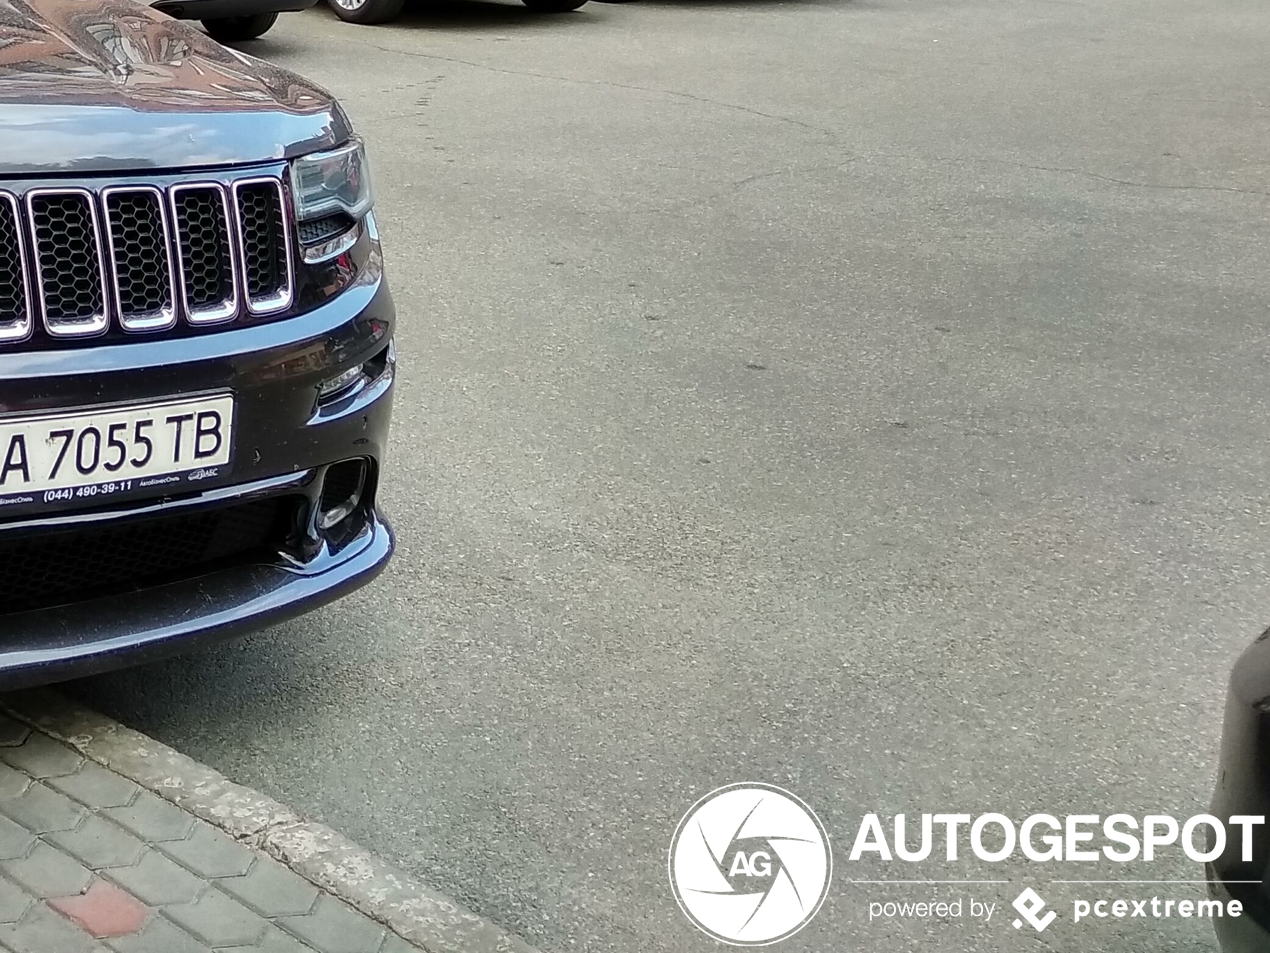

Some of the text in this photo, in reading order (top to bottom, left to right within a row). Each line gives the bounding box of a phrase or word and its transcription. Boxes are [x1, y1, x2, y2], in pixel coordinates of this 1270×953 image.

[47, 418, 154, 480] 7055
[165, 409, 223, 464] TB
[43, 480, 132, 504] (044) 490-39-11
